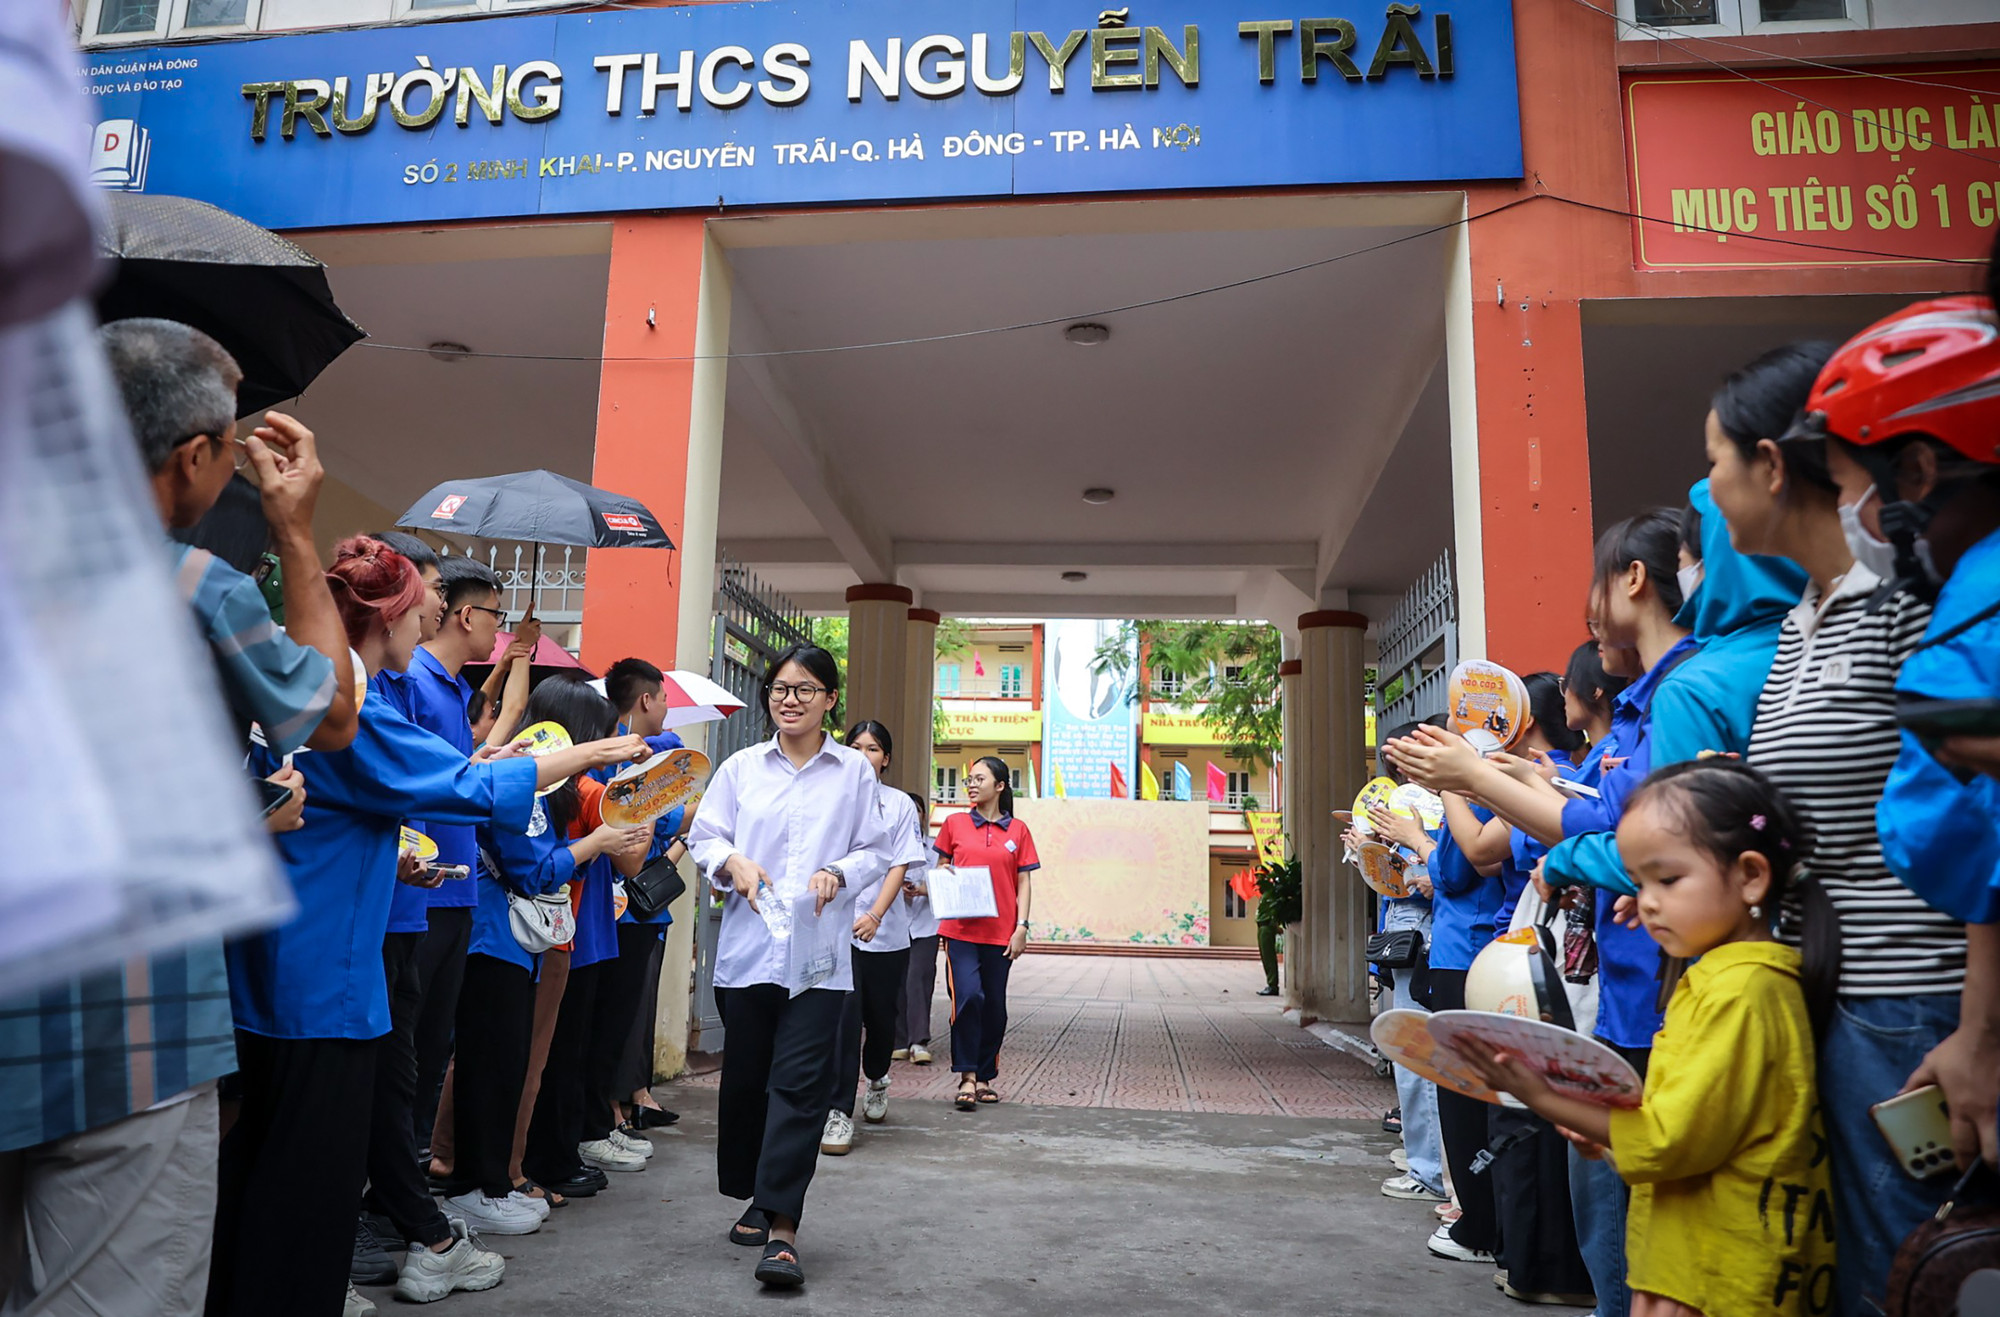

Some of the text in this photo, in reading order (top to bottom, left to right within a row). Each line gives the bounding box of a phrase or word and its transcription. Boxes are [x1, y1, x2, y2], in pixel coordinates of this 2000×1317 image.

[92, 83, 114, 95] DỤC
[117, 81, 131, 92] VÀ
[134, 79, 158, 92] ĐÀO
[161, 79, 182, 91] TẠO
[115, 62, 146, 75] QUẬN
[148, 59, 163, 71] HÀ
[166, 58, 198, 70] ĐÔNG
[242, 2, 1454, 140] TRƯỜNG THCS NGUYỄN TRÃI
[104, 133, 120, 151] D
[403, 158, 439, 184] SỐ
[443, 163, 459, 182] 2
[467, 158, 528, 181] MINH
[645, 142, 755, 171] NGUYỄN
[888, 133, 924, 160] HÀ
[942, 130, 1025, 157] ĐÔNG
[1050, 130, 1091, 153] TP.
[1099, 123, 1141, 150] HÀ
[1152, 123, 1200, 151] NỘI
[1751, 95, 2000, 162] GIÁO DỤC LÀ
[1671, 168, 2000, 242] MỤC TIÊU SỐ 1 C
